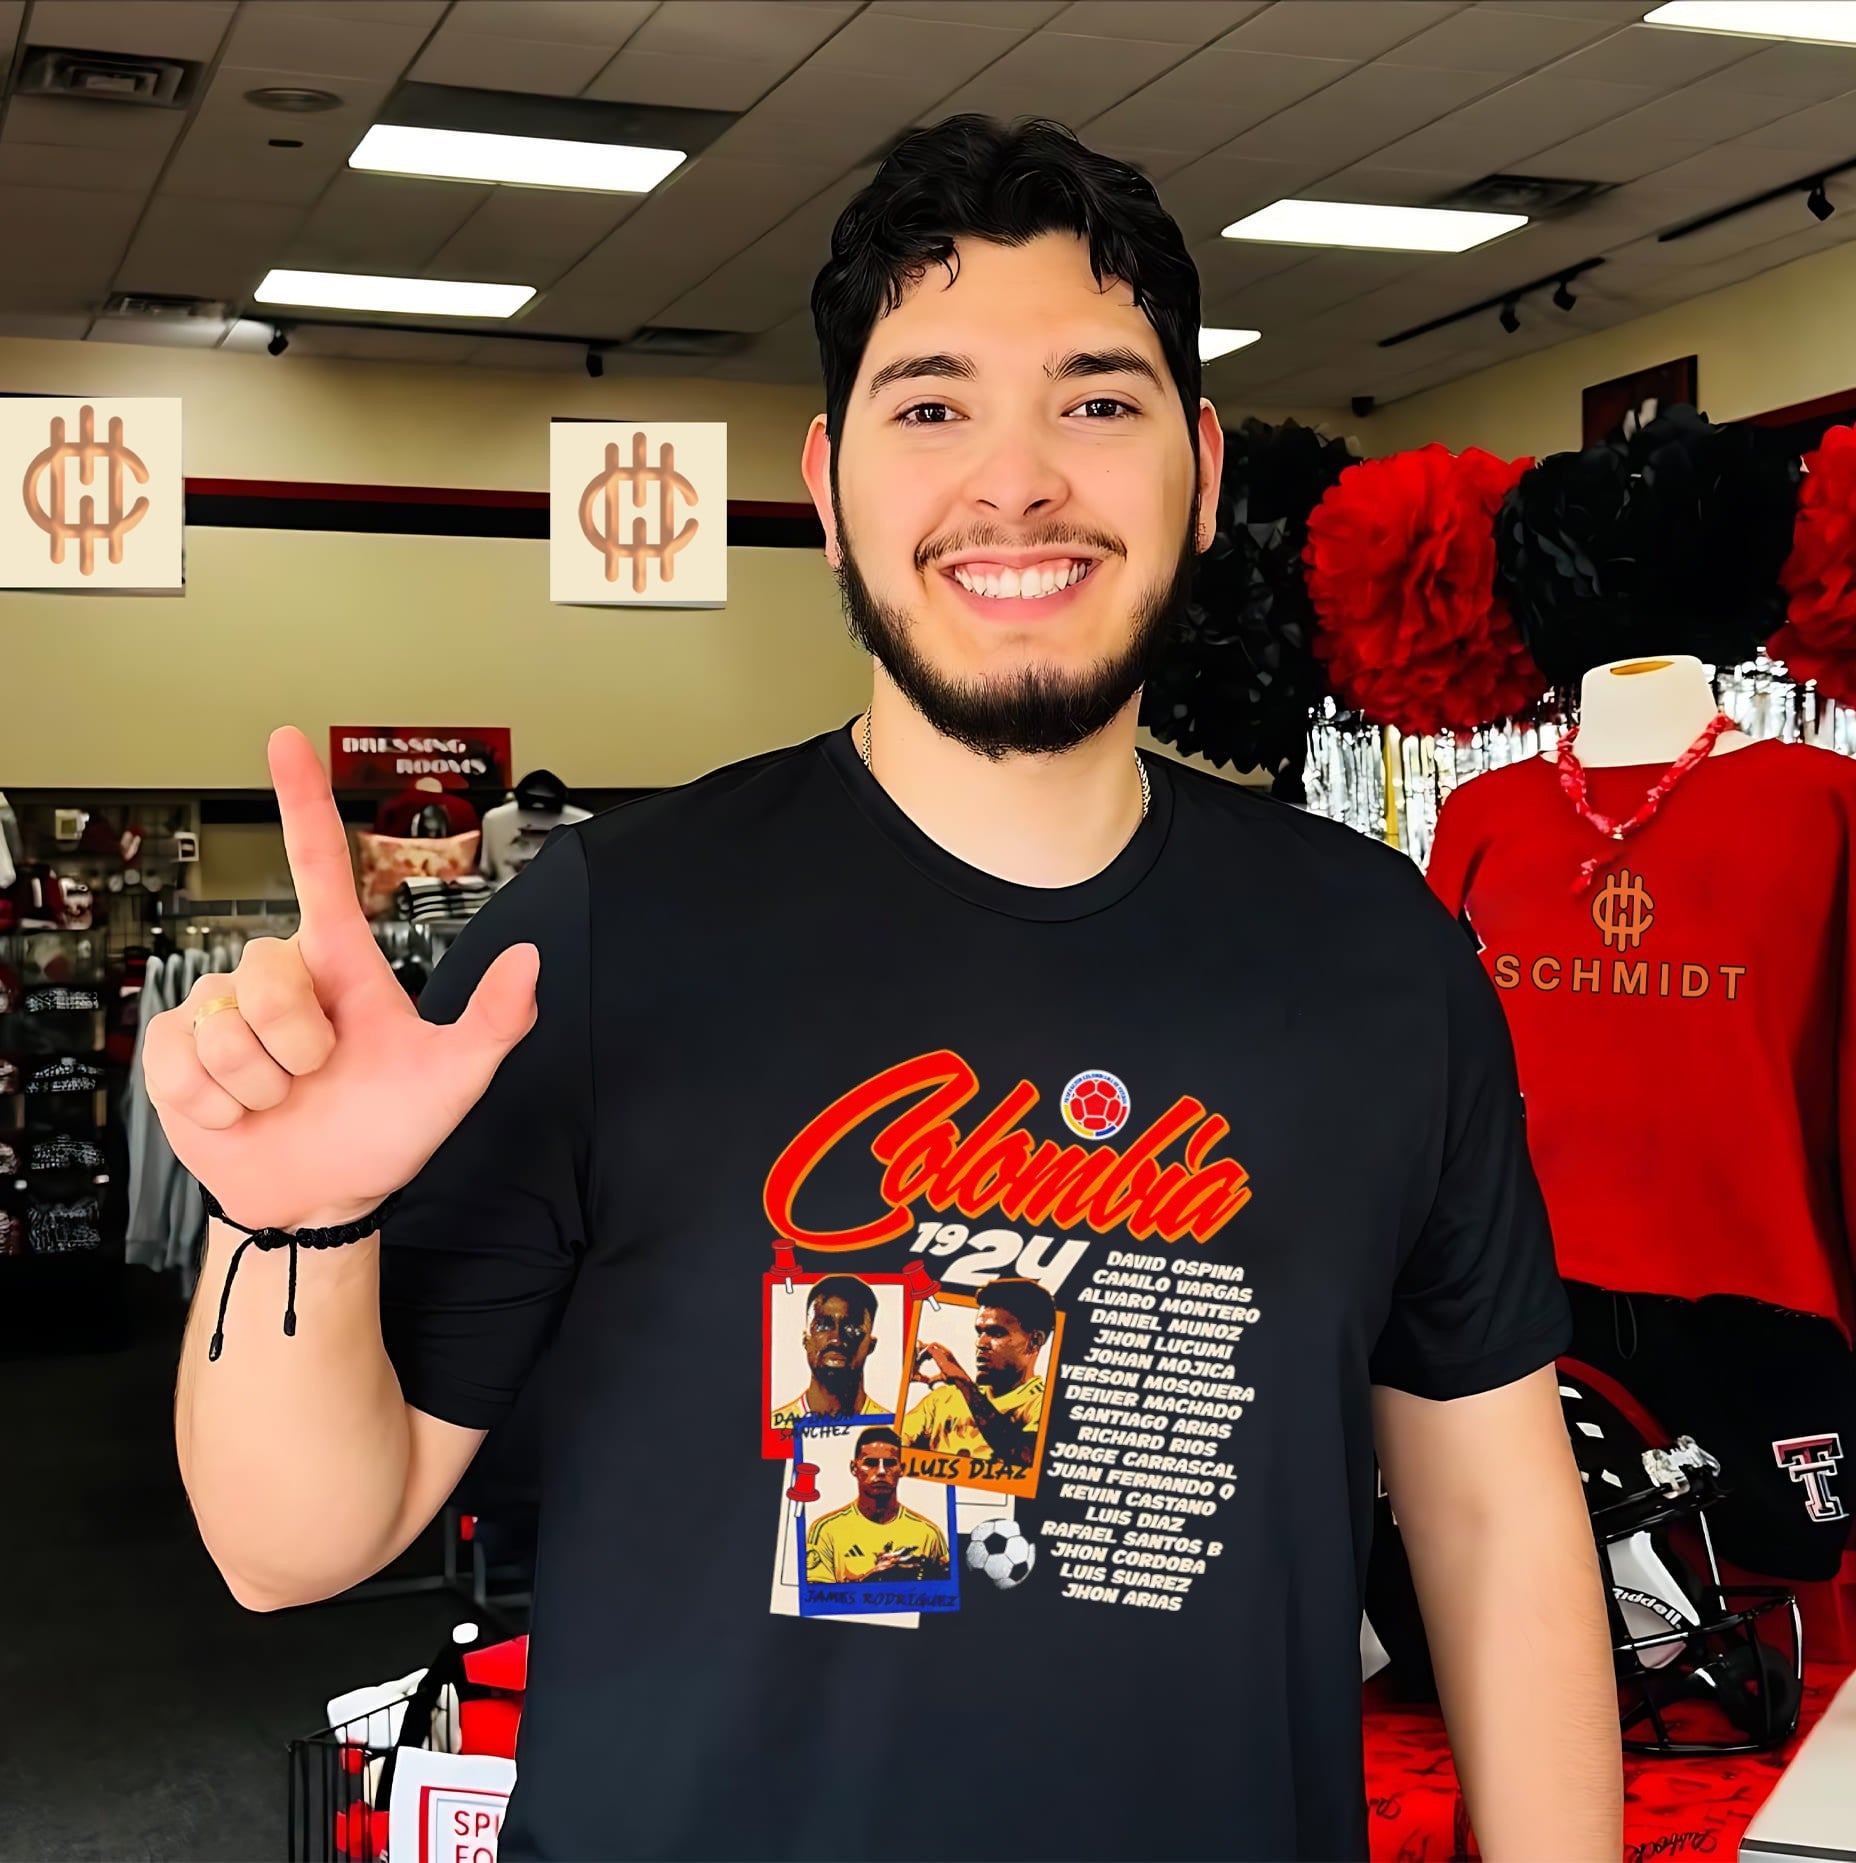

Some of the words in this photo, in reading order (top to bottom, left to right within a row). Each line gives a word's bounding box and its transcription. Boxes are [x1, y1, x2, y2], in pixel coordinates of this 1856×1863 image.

[342, 737, 467, 754] DRESSING
[396, 758, 487, 775] ROOMS
[1494, 954, 1747, 1000] SCHMIDT
[763, 1048, 1253, 1252] Colombia
[1106, 1251, 1167, 1271] DAVID
[1171, 1259, 1244, 1281] OSPINA
[1092, 1270, 1171, 1292] CAMILO
[1176, 1280, 1253, 1303] VARGAS
[1077, 1287, 1156, 1310] ALVARO
[1159, 1298, 1261, 1324] MONTERO
[1090, 1309, 1162, 1331] DANIEL
[1167, 1319, 1244, 1342] MUNOZ
[1094, 1329, 1151, 1349] JHON
[1154, 1336, 1234, 1359] LUCUMI
[1084, 1348, 1154, 1370] JOHAN
[1157, 1356, 1236, 1380] MOJICA
[1060, 1364, 1140, 1388] YERSON
[1143, 1376, 1255, 1402] MOSQUERA
[1065, 1385, 1139, 1407] DEIVER
[1142, 1395, 1243, 1420] MACHADO
[1069, 1406, 1168, 1431] SANTIAGO
[1172, 1419, 1233, 1439] ARIAS
[1077, 1426, 1165, 1450] RICHARD
[1168, 1438, 1218, 1457] RIOS
[906, 1457, 960, 1479] LUIS
[968, 1458, 1027, 1480] DIAZ
[1049, 1442, 1120, 1465] JORGE
[1122, 1452, 1238, 1480] CARRASCAL
[1047, 1463, 1103, 1482] JUAN
[1106, 1469, 1215, 1496] FERNANDO
[1219, 1483, 1235, 1500] Q
[1060, 1483, 1122, 1504] KEVIN
[1125, 1491, 1217, 1516] CASTANO
[1085, 1507, 1133, 1525] LUIS
[1136, 1513, 1185, 1532] DIAZ
[1040, 1521, 1118, 1544] RAFAEL
[1123, 1531, 1203, 1555] SANTOS
[1206, 1542, 1224, 1557] B
[1050, 1542, 1109, 1562] JHON
[1111, 1550, 1206, 1574] CORDOBA
[1059, 1563, 1107, 1582] LUIS
[1110, 1570, 1193, 1593] SUAREZ
[805, 1590, 857, 1605] JAMES
[1061, 1583, 1120, 1604] JHON
[1122, 1590, 1183, 1611] ARIAS
